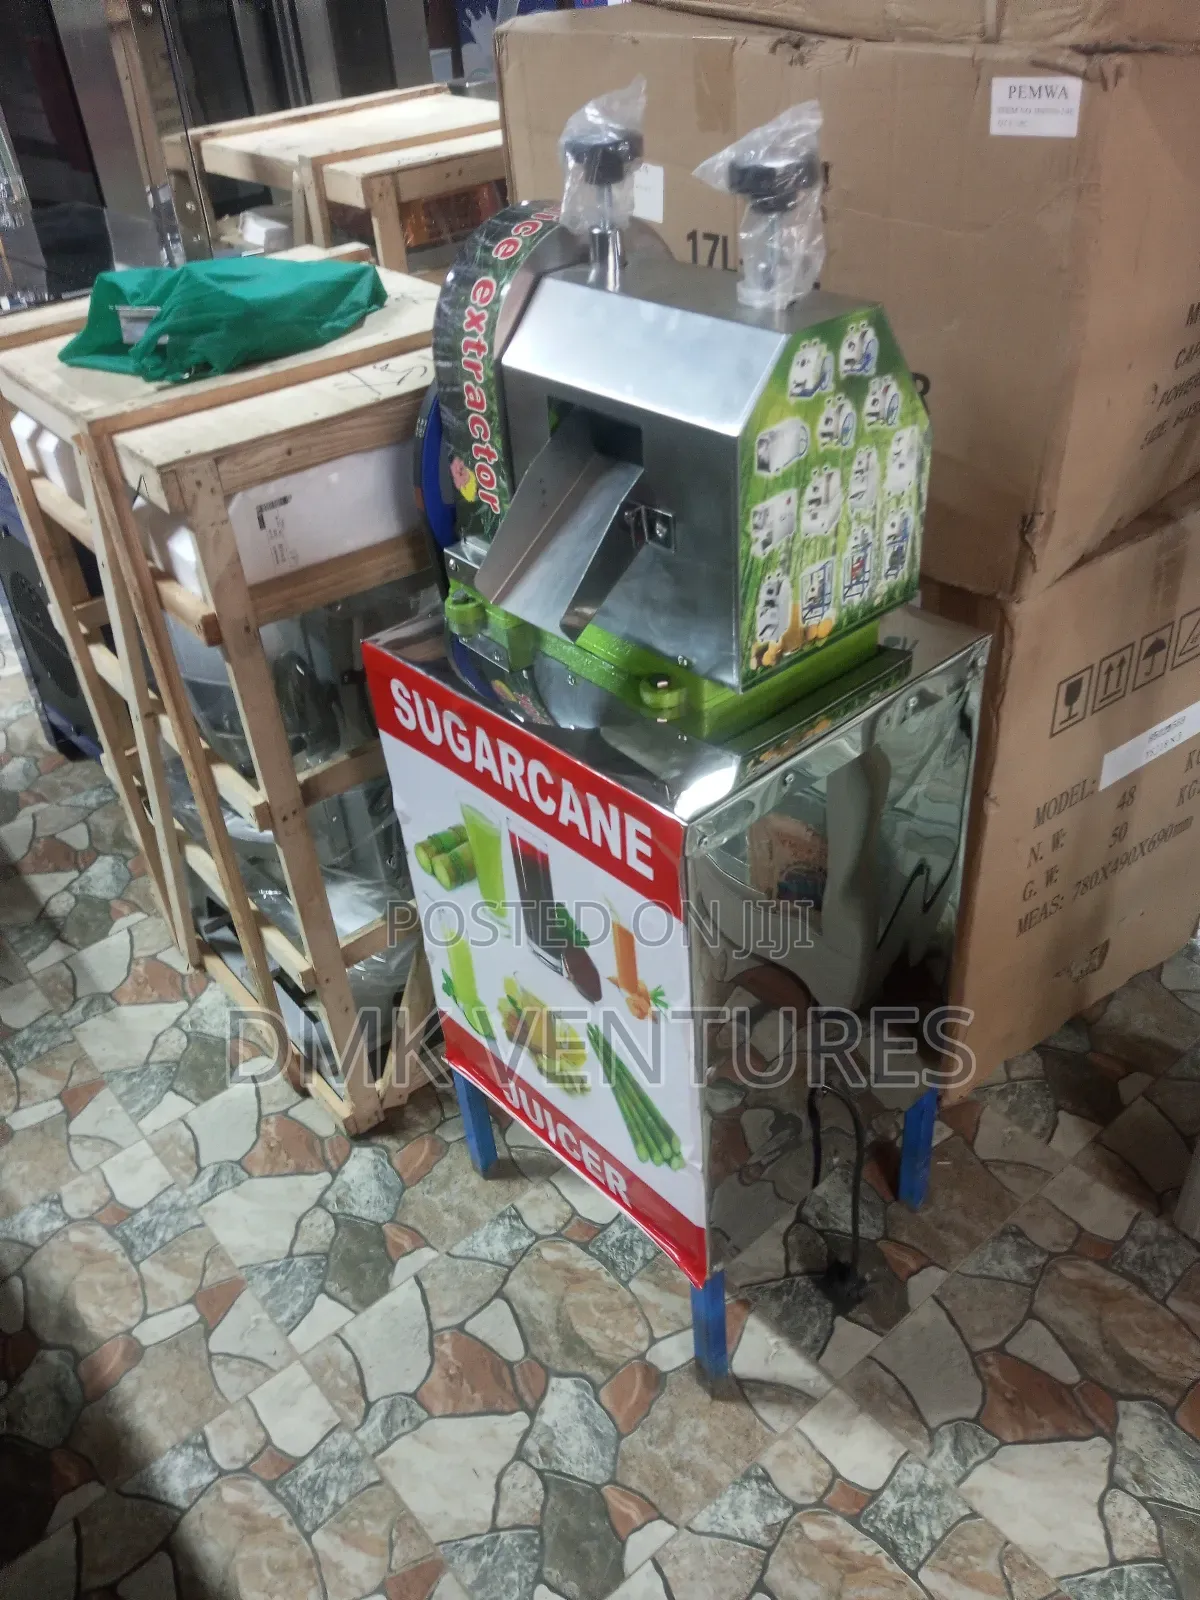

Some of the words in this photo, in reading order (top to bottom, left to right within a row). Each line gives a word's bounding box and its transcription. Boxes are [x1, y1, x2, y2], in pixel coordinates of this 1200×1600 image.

[1007, 83, 1069, 100] PEMWA
[461, 275, 501, 514] extractor
[389, 678, 655, 882] SUGARCANE
[1116, 784, 1137, 811] 48
[1033, 779, 1097, 829] MODEL:
[1108, 821, 1129, 849] 50
[1016, 893, 1065, 938] MEAS:
[502, 1077, 633, 1210] JUICER
